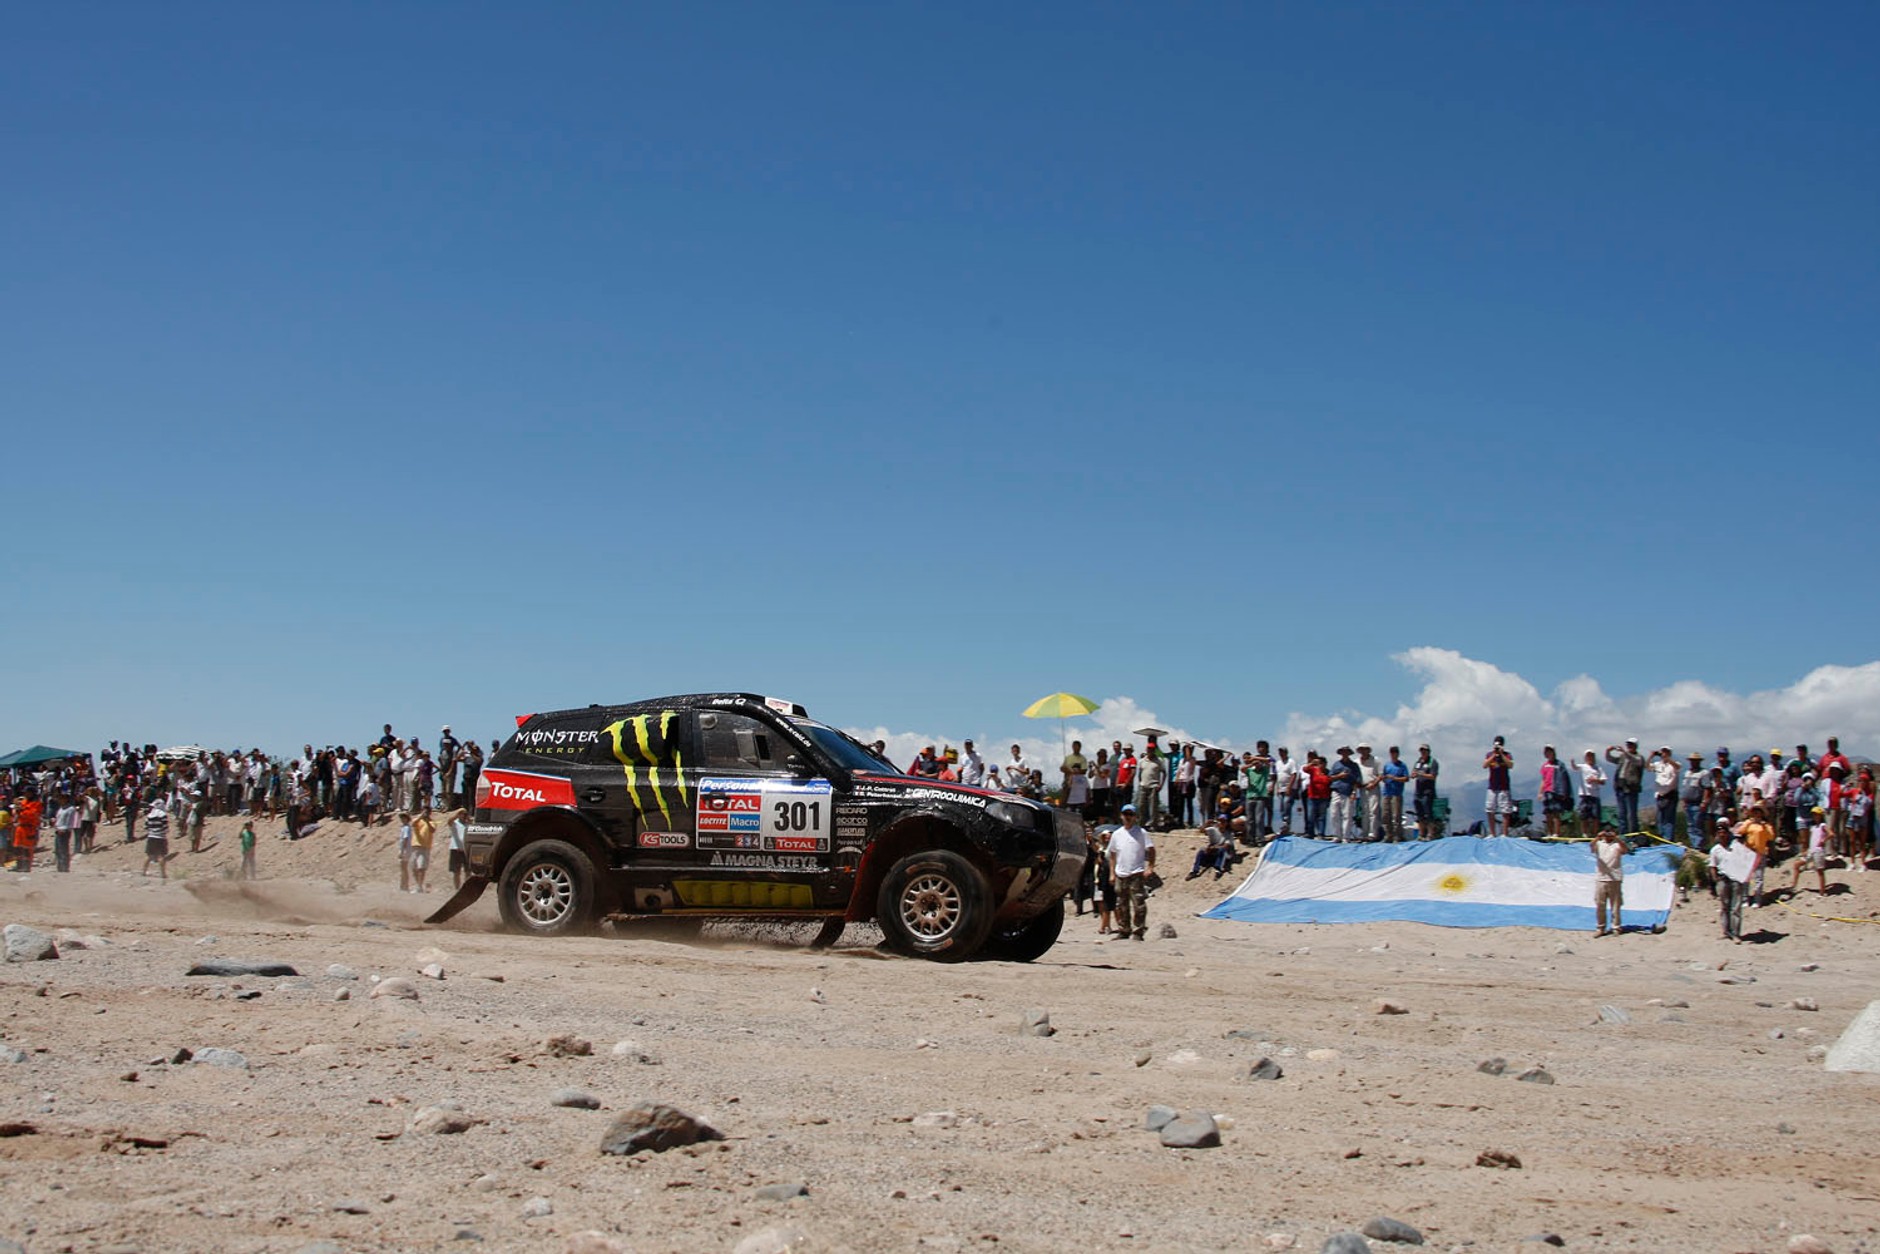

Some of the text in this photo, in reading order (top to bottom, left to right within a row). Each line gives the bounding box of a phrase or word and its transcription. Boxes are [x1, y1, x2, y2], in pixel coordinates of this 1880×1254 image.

[491, 781, 547, 802] TOTAL
[730, 817, 760, 827] Macro
[774, 801, 820, 831] 301
[777, 839, 815, 849] TOTAL
[724, 855, 818, 868] MAGNA STEYR
